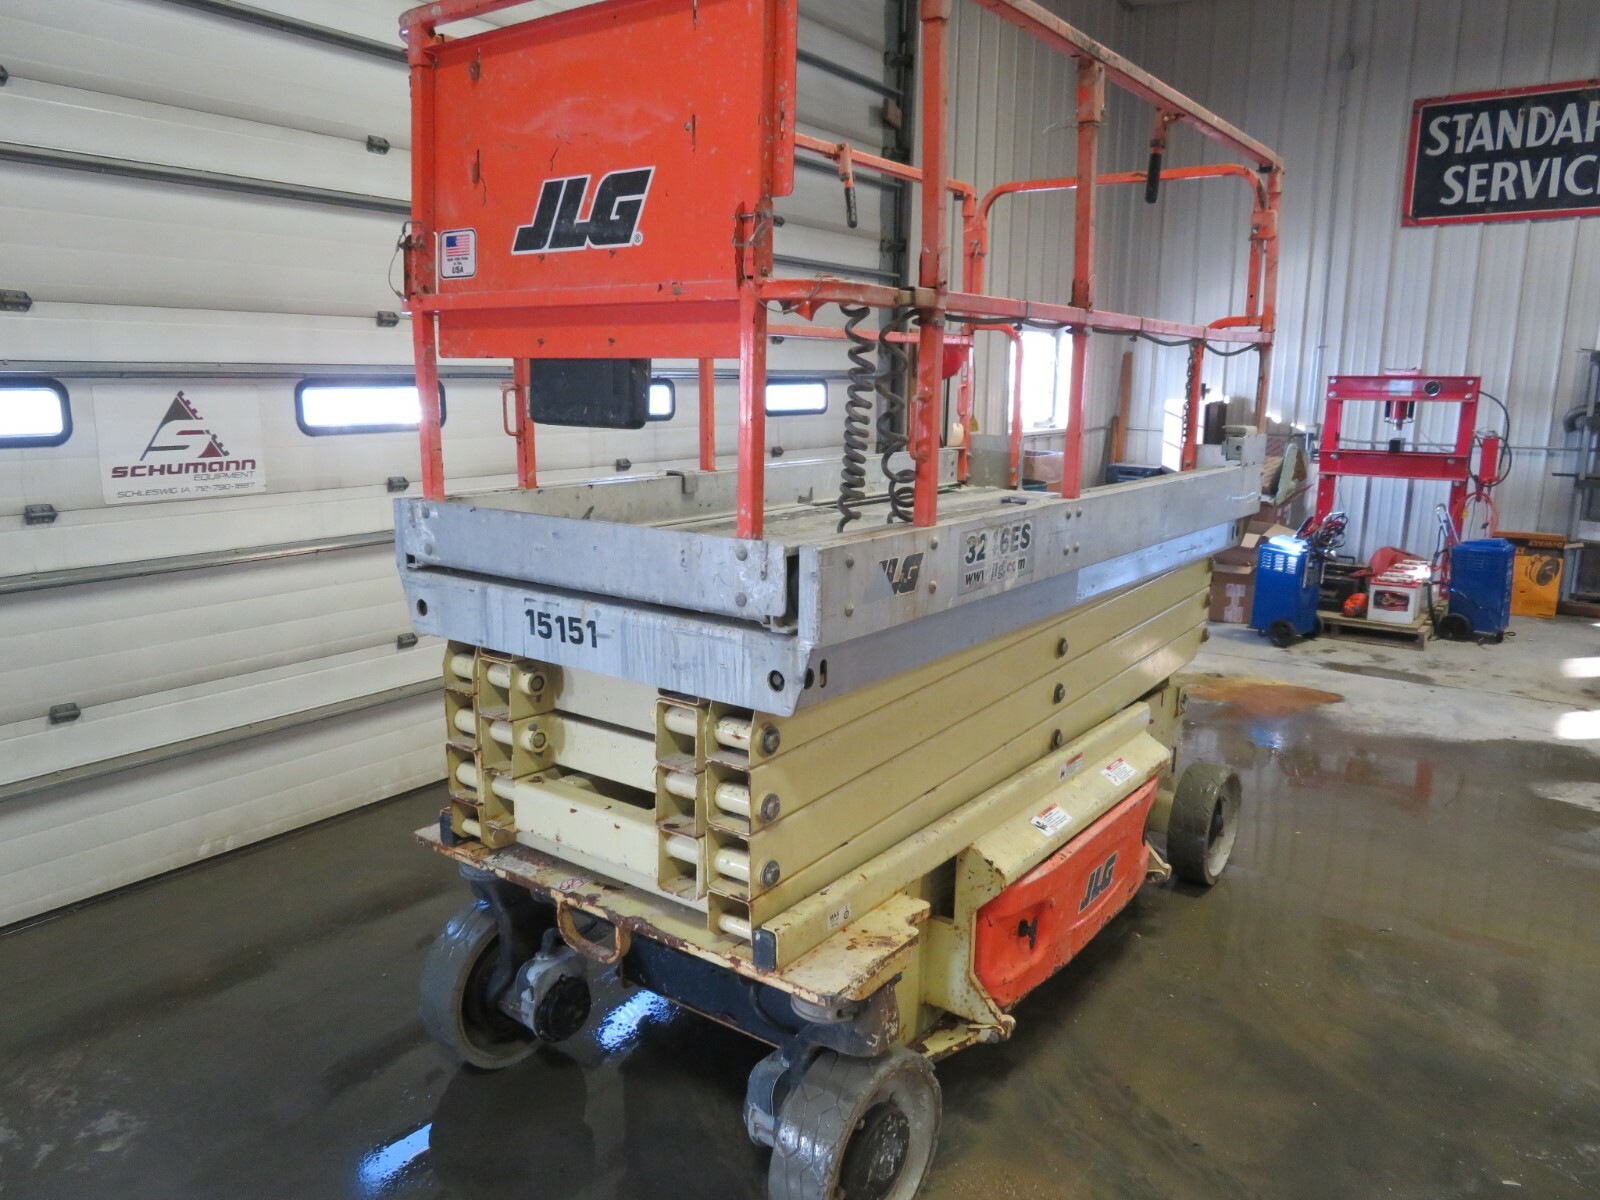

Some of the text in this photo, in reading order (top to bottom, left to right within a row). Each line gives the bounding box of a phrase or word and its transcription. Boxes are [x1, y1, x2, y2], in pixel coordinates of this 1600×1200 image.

[1439, 153, 1600, 206] SERVIC
[193, 471, 255, 481] EQUIPMENT
[964, 523, 1032, 565] 326ES
[525, 608, 598, 649] 15151
[1078, 850, 1118, 914] JLG
